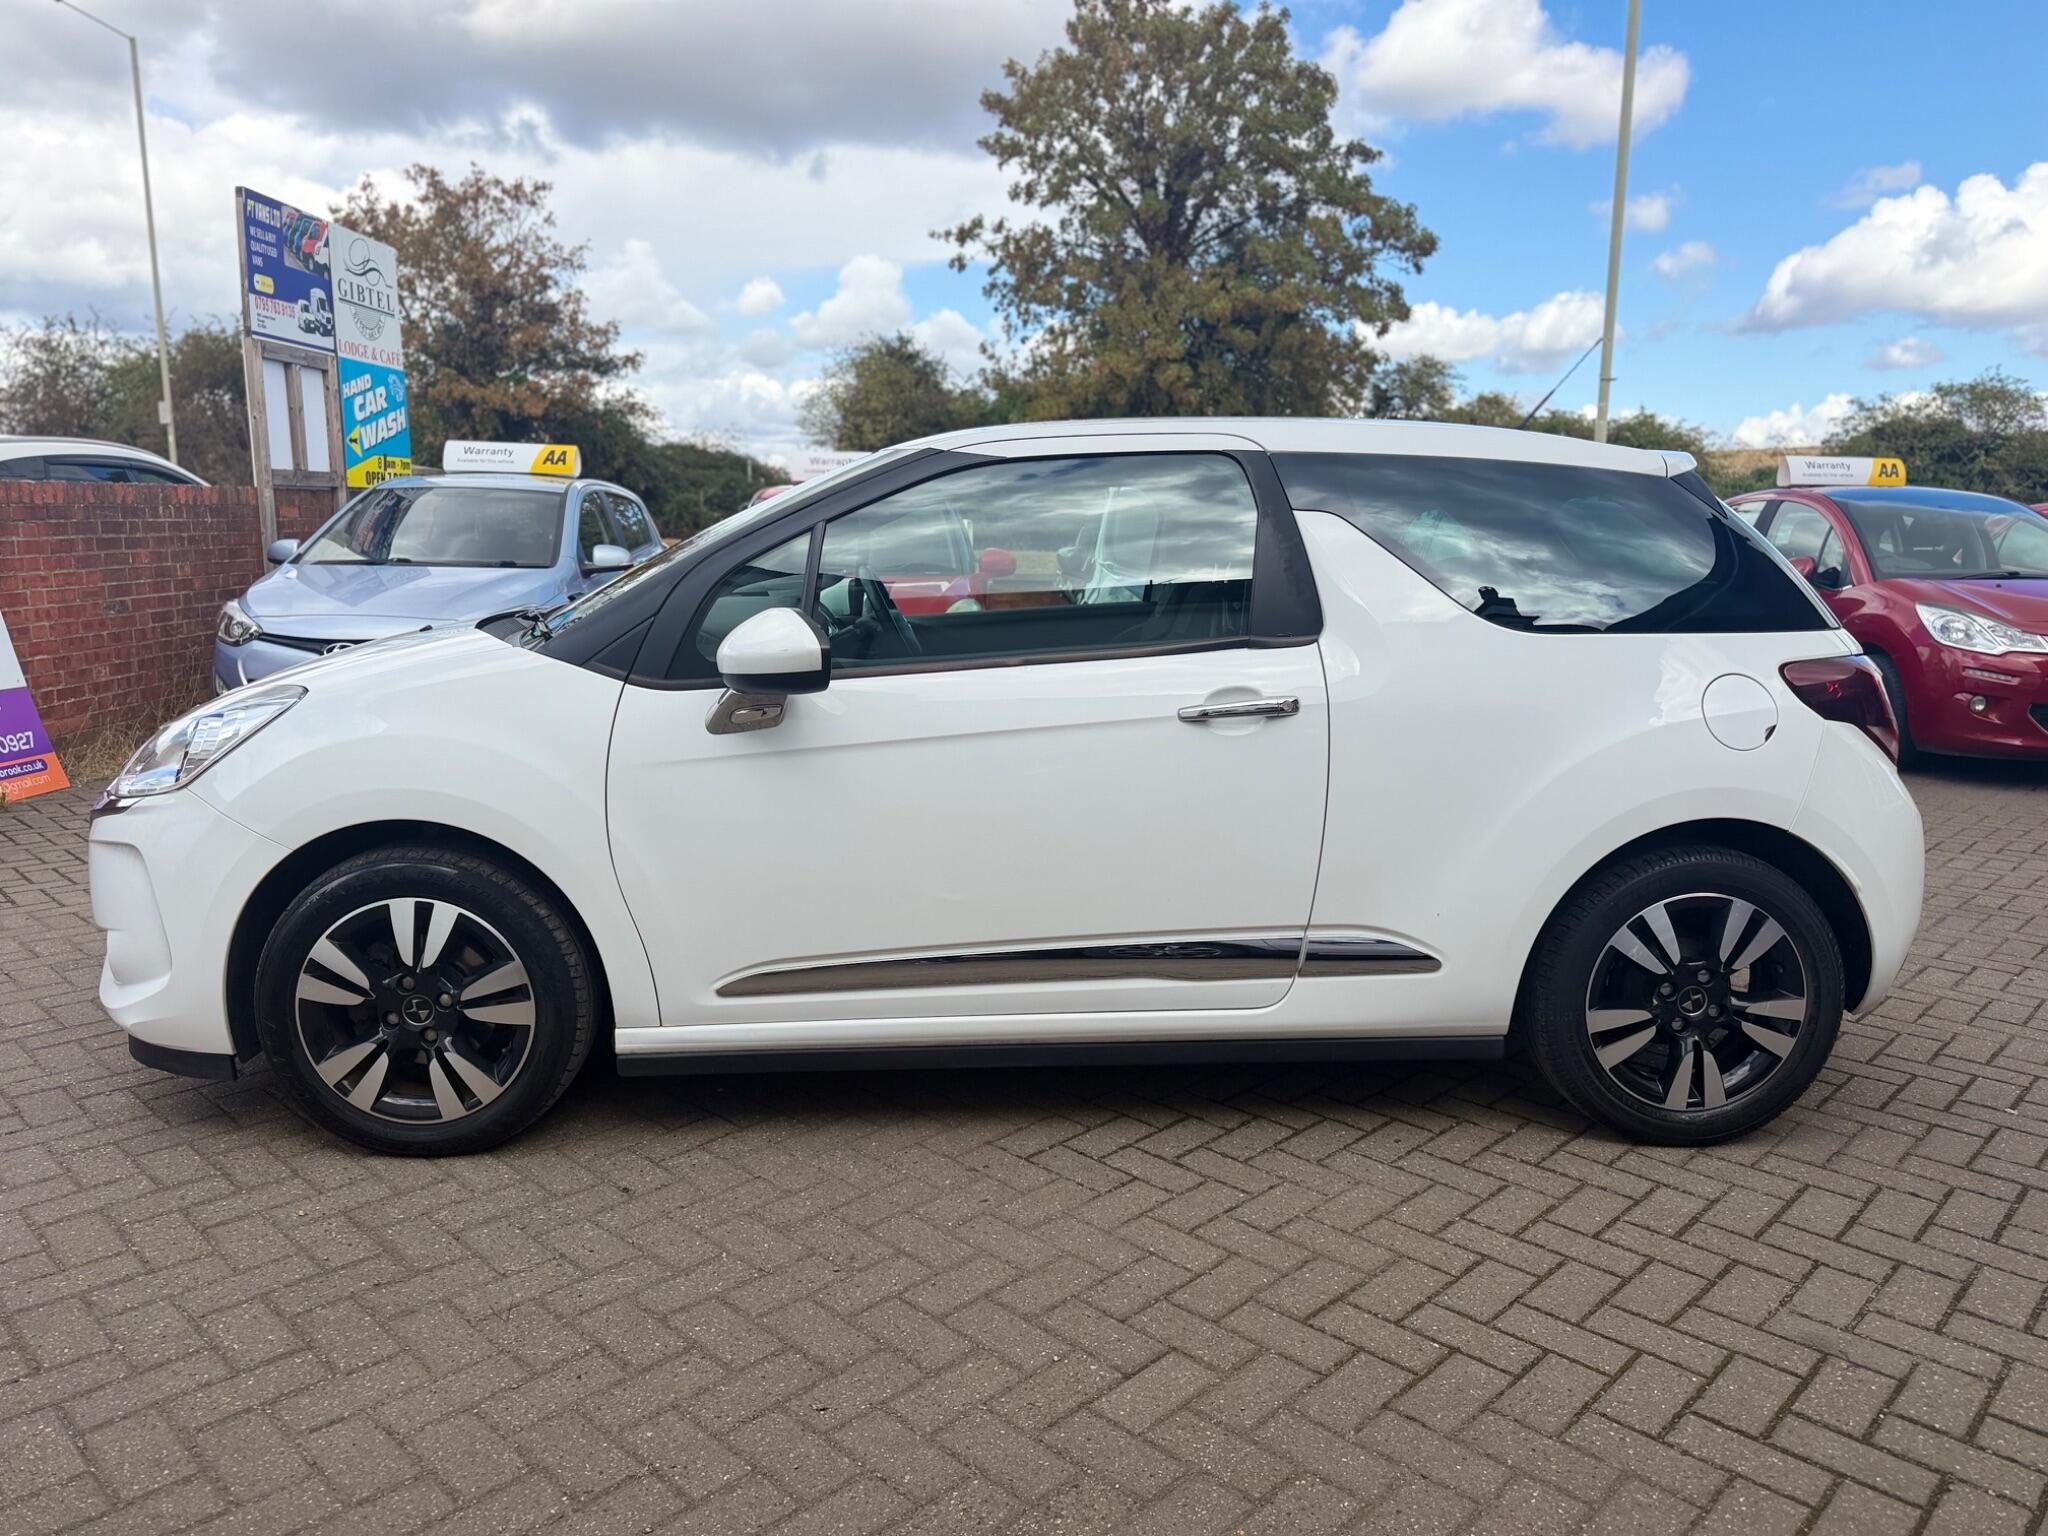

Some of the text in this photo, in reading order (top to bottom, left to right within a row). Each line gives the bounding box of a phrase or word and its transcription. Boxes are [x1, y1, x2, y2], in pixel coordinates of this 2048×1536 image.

[255, 201, 270, 225] VANS
[270, 206, 281, 229] LTD
[250, 240, 278, 258] QUALITY USED
[251, 254, 264, 267] VANS
[337, 277, 395, 313] GIBTEL
[338, 338, 368, 360] LODGE
[371, 346, 378, 361] &
[342, 373, 372, 399] HAND
[354, 385, 388, 421] CAR
[360, 406, 407, 450] WASH
[463, 446, 514, 457] Warranty
[542, 450, 568, 465] AA
[809, 456, 855, 466] Warrant
[1804, 460, 1850, 471] Warranty
[1878, 463, 1899, 478] AA
[365, 470, 386, 485] OPEN
[0, 731, 35, 754] 0927
[0, 775, 51, 795] @gmail.com
